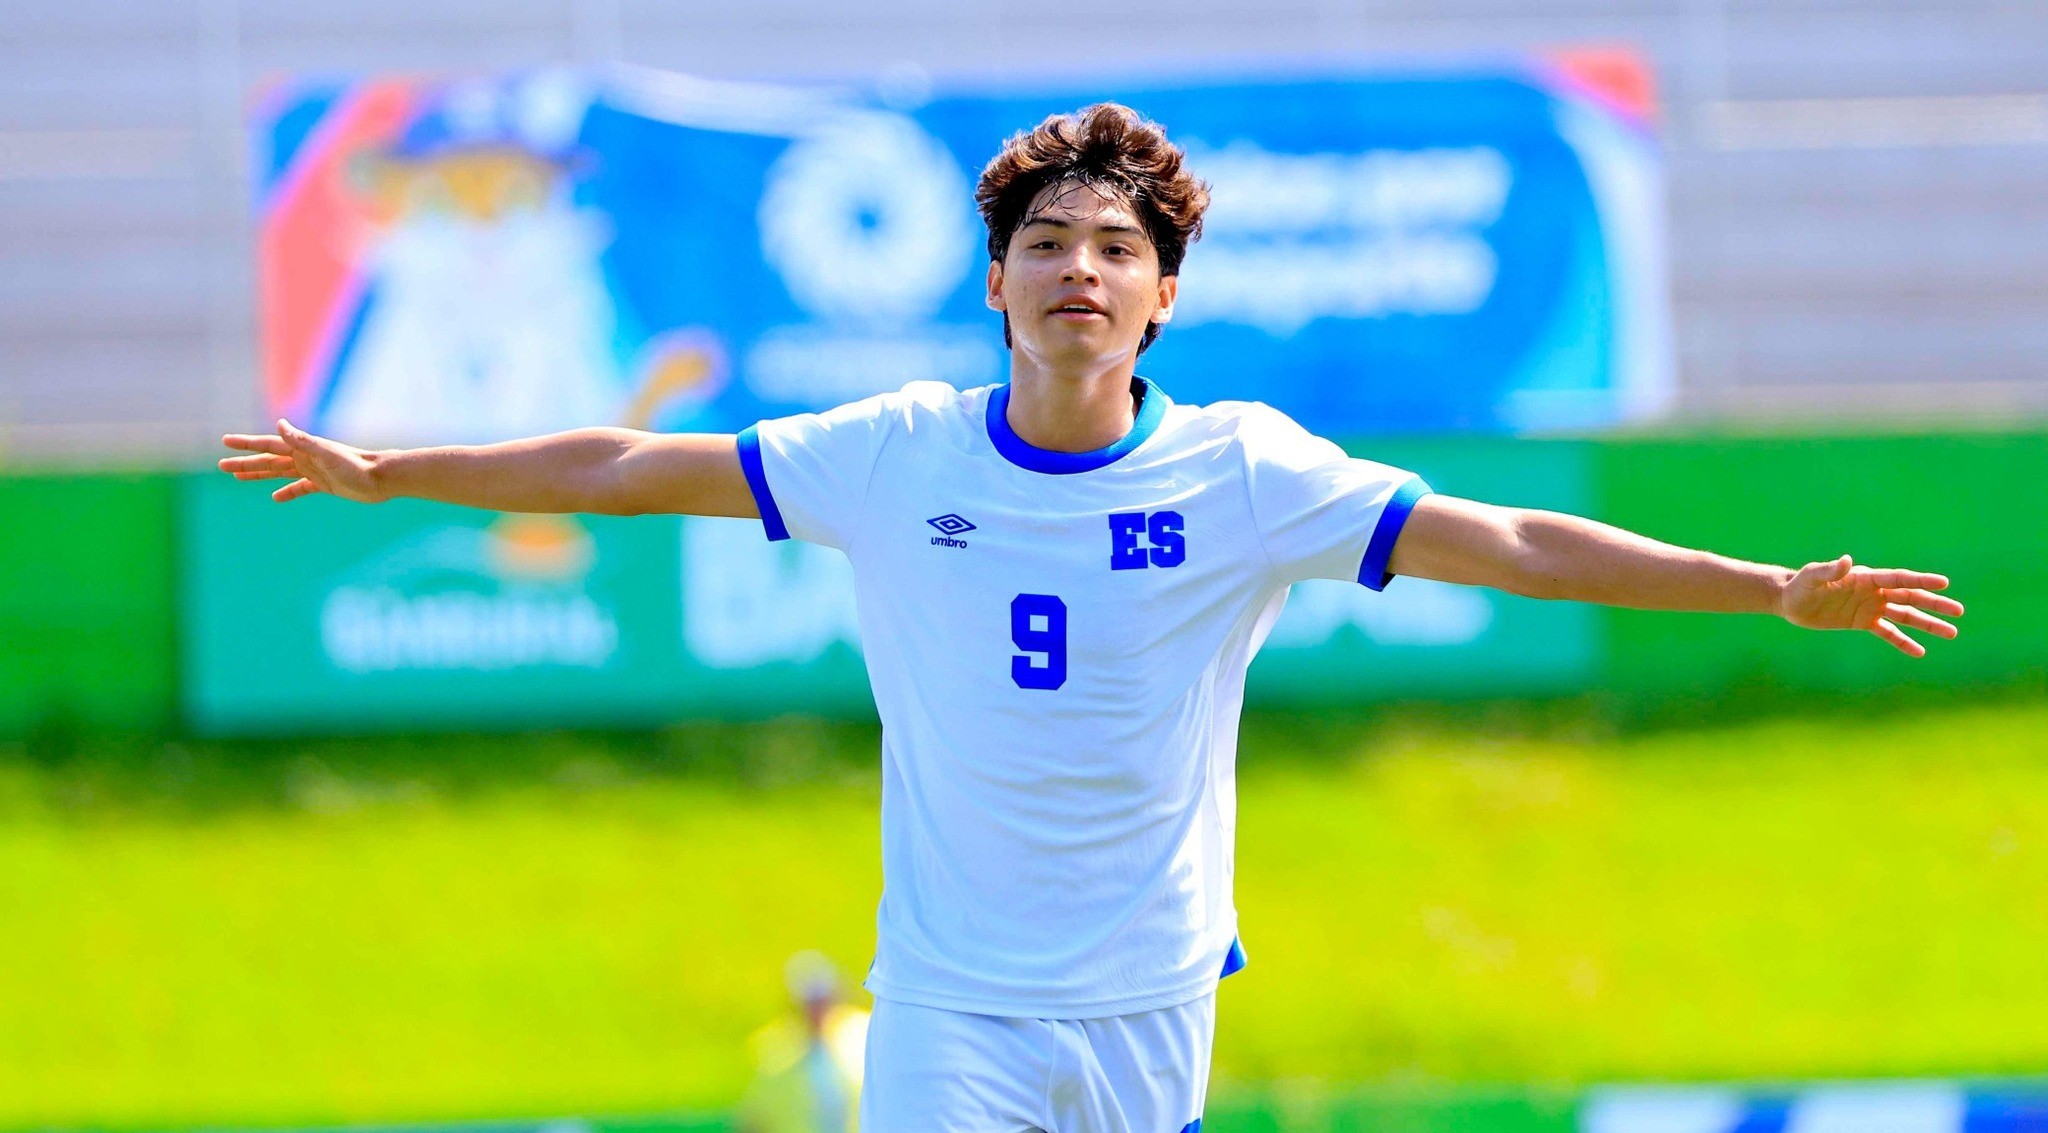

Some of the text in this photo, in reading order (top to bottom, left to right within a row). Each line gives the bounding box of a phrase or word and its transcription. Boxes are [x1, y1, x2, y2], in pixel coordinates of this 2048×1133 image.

[930, 536, 967, 549] umbro
[1108, 511, 1186, 570] ES
[1010, 593, 1067, 690] 9
